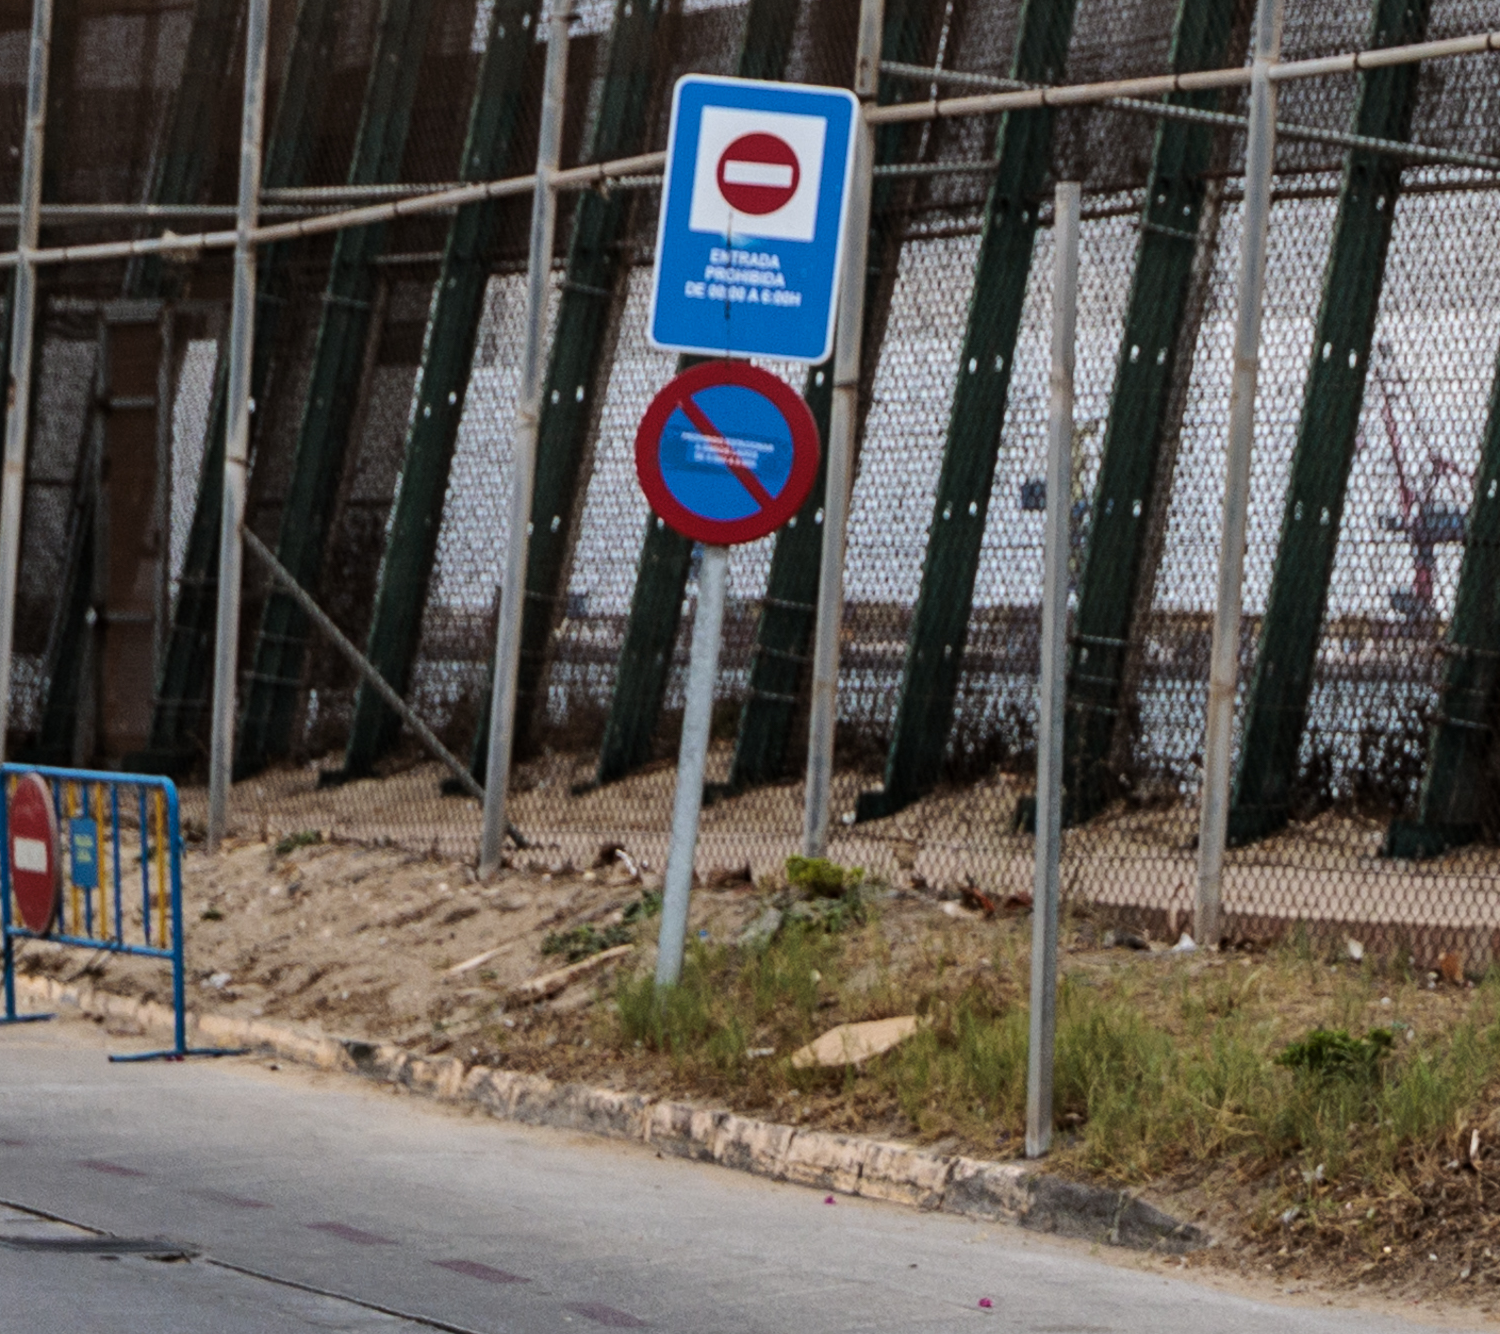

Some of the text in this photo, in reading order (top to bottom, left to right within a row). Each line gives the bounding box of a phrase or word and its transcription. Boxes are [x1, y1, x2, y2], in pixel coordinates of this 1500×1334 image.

[709, 247, 781, 270] ENTRADA
[704, 265, 786, 289] PROHIBIDA
[684, 280, 706, 299] DE
[747, 287, 760, 304] A
